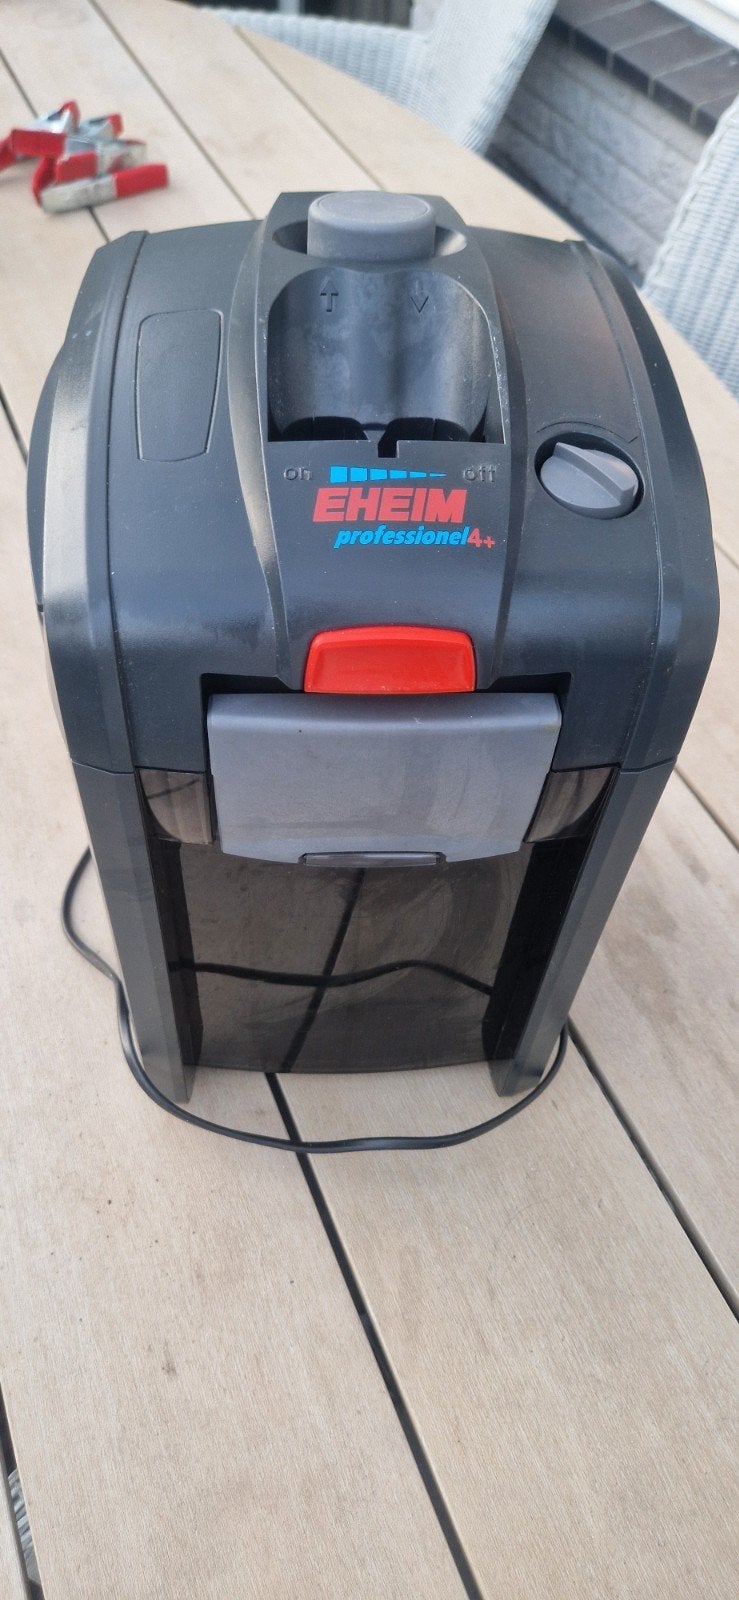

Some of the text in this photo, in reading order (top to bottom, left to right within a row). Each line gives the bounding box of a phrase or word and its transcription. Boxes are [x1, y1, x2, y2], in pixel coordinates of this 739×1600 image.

[283, 466, 313, 482] on
[462, 464, 497, 483] off
[312, 487, 468, 523] EHEIM
